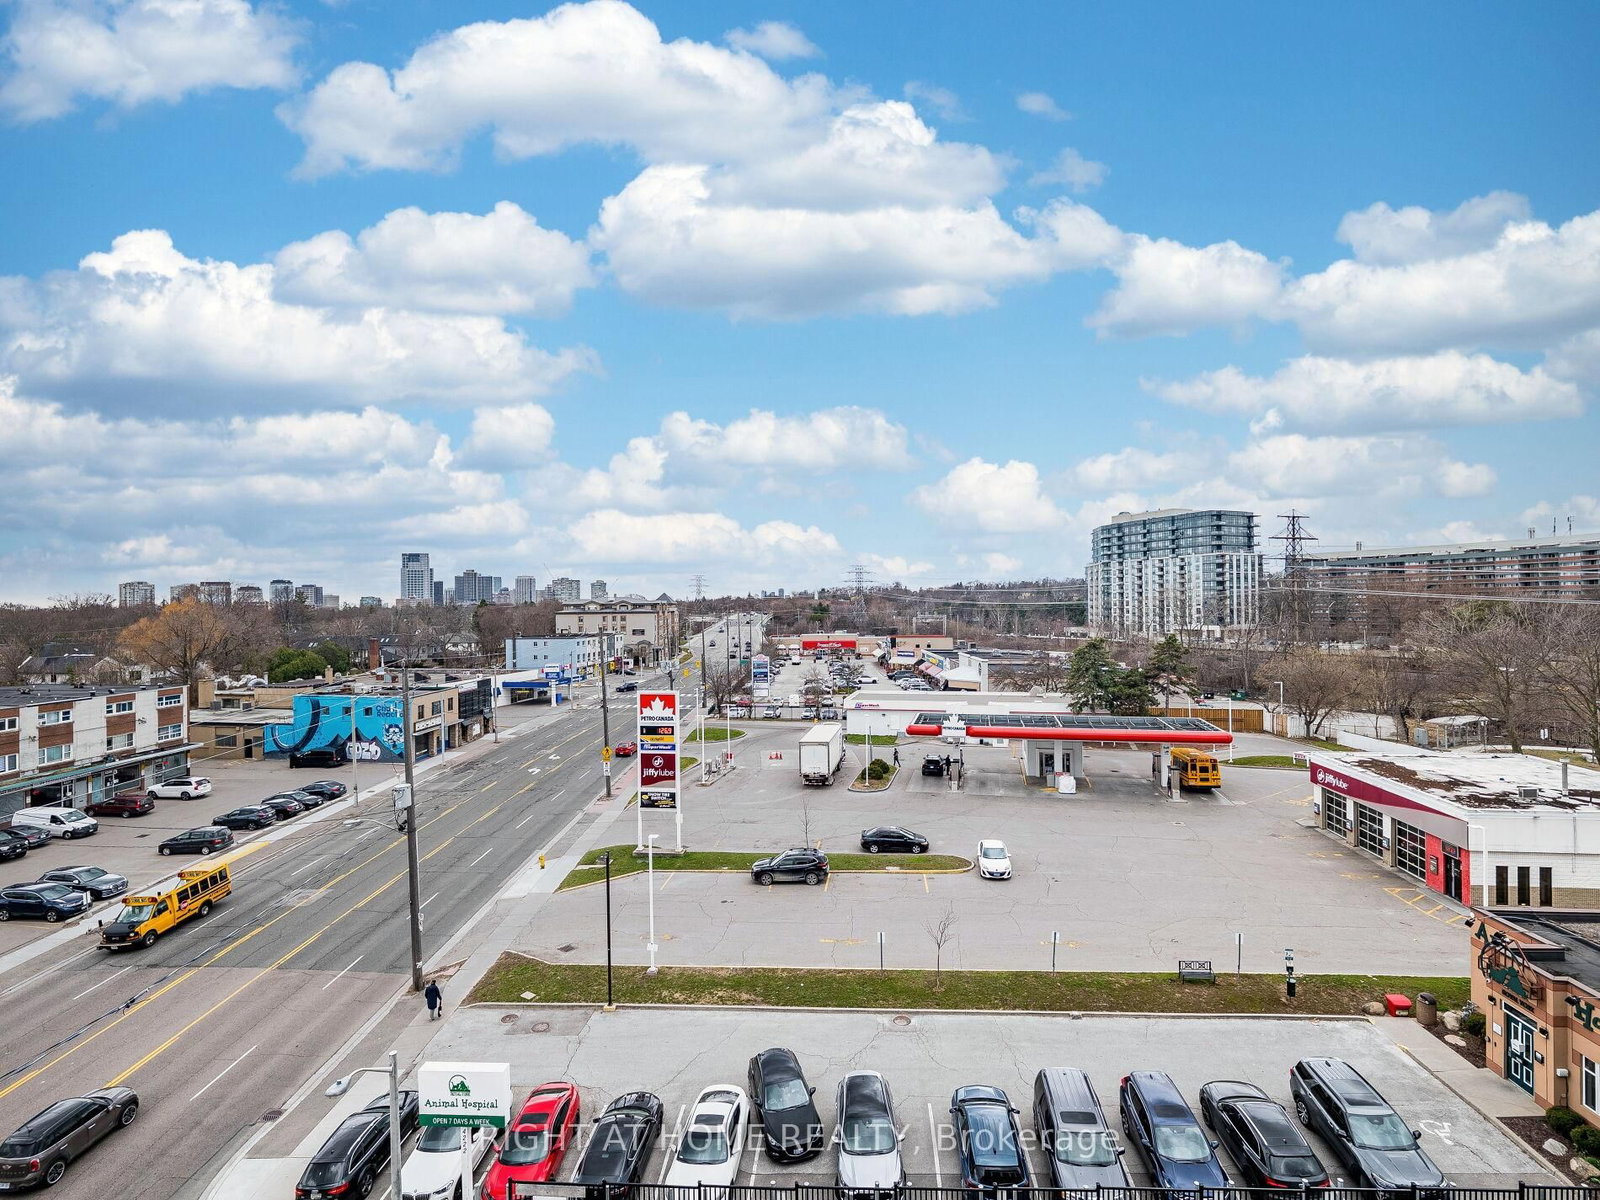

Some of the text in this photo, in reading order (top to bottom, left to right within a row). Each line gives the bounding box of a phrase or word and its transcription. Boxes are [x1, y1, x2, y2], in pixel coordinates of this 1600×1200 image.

[425, 1098, 498, 1110] Animal Hospital
[432, 1117, 490, 1126] OPEN 7 DAYS A WEEK
